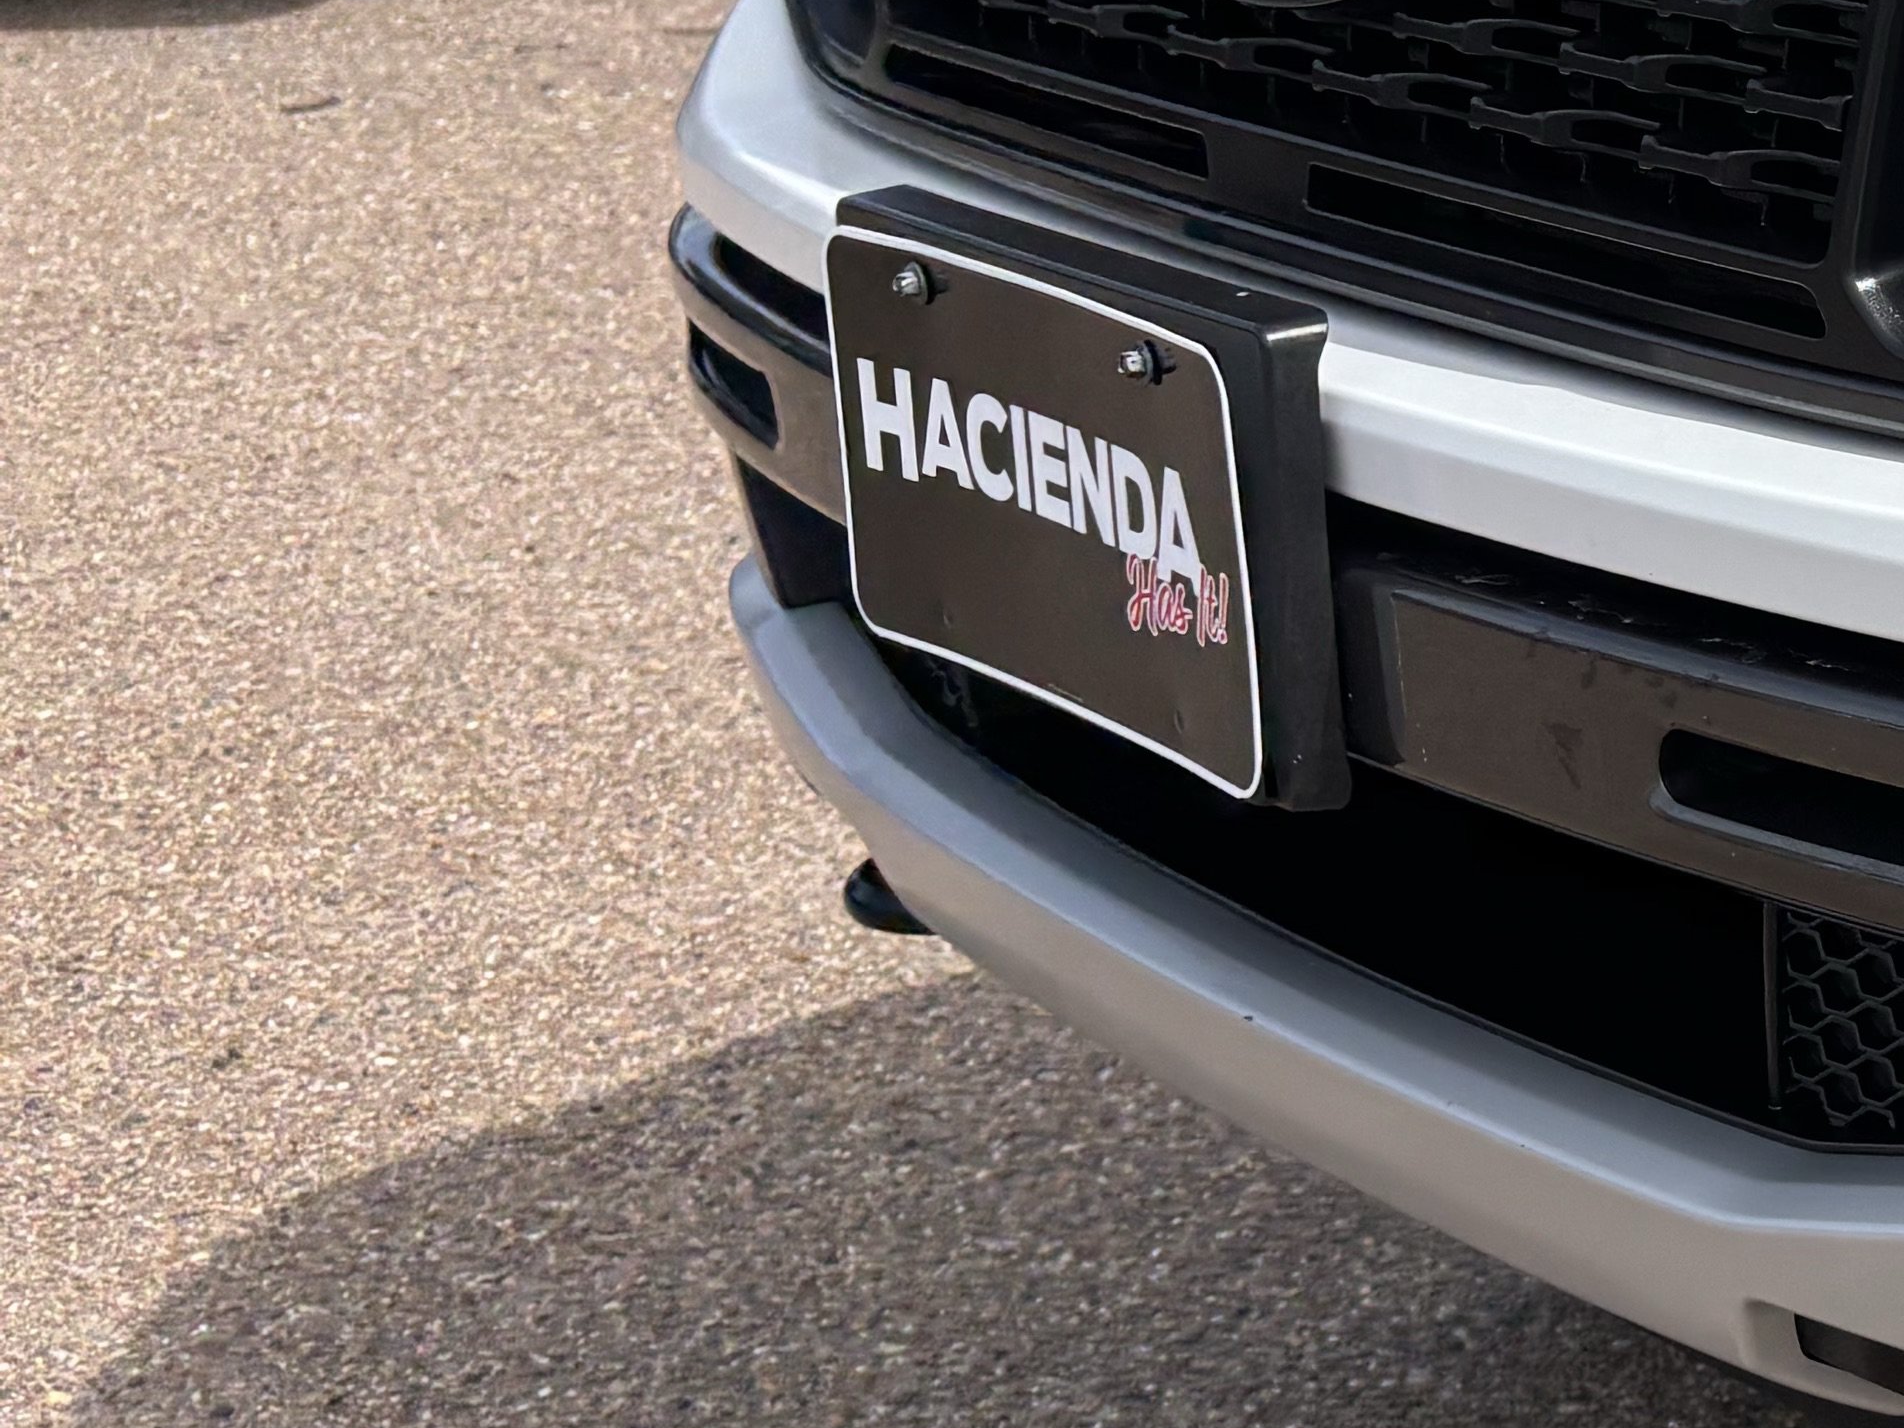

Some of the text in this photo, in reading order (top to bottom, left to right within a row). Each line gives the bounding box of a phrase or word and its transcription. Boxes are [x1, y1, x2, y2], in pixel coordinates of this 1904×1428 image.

[855, 357, 1202, 598] HACIENDA
[1126, 553, 1230, 648] Has It!
